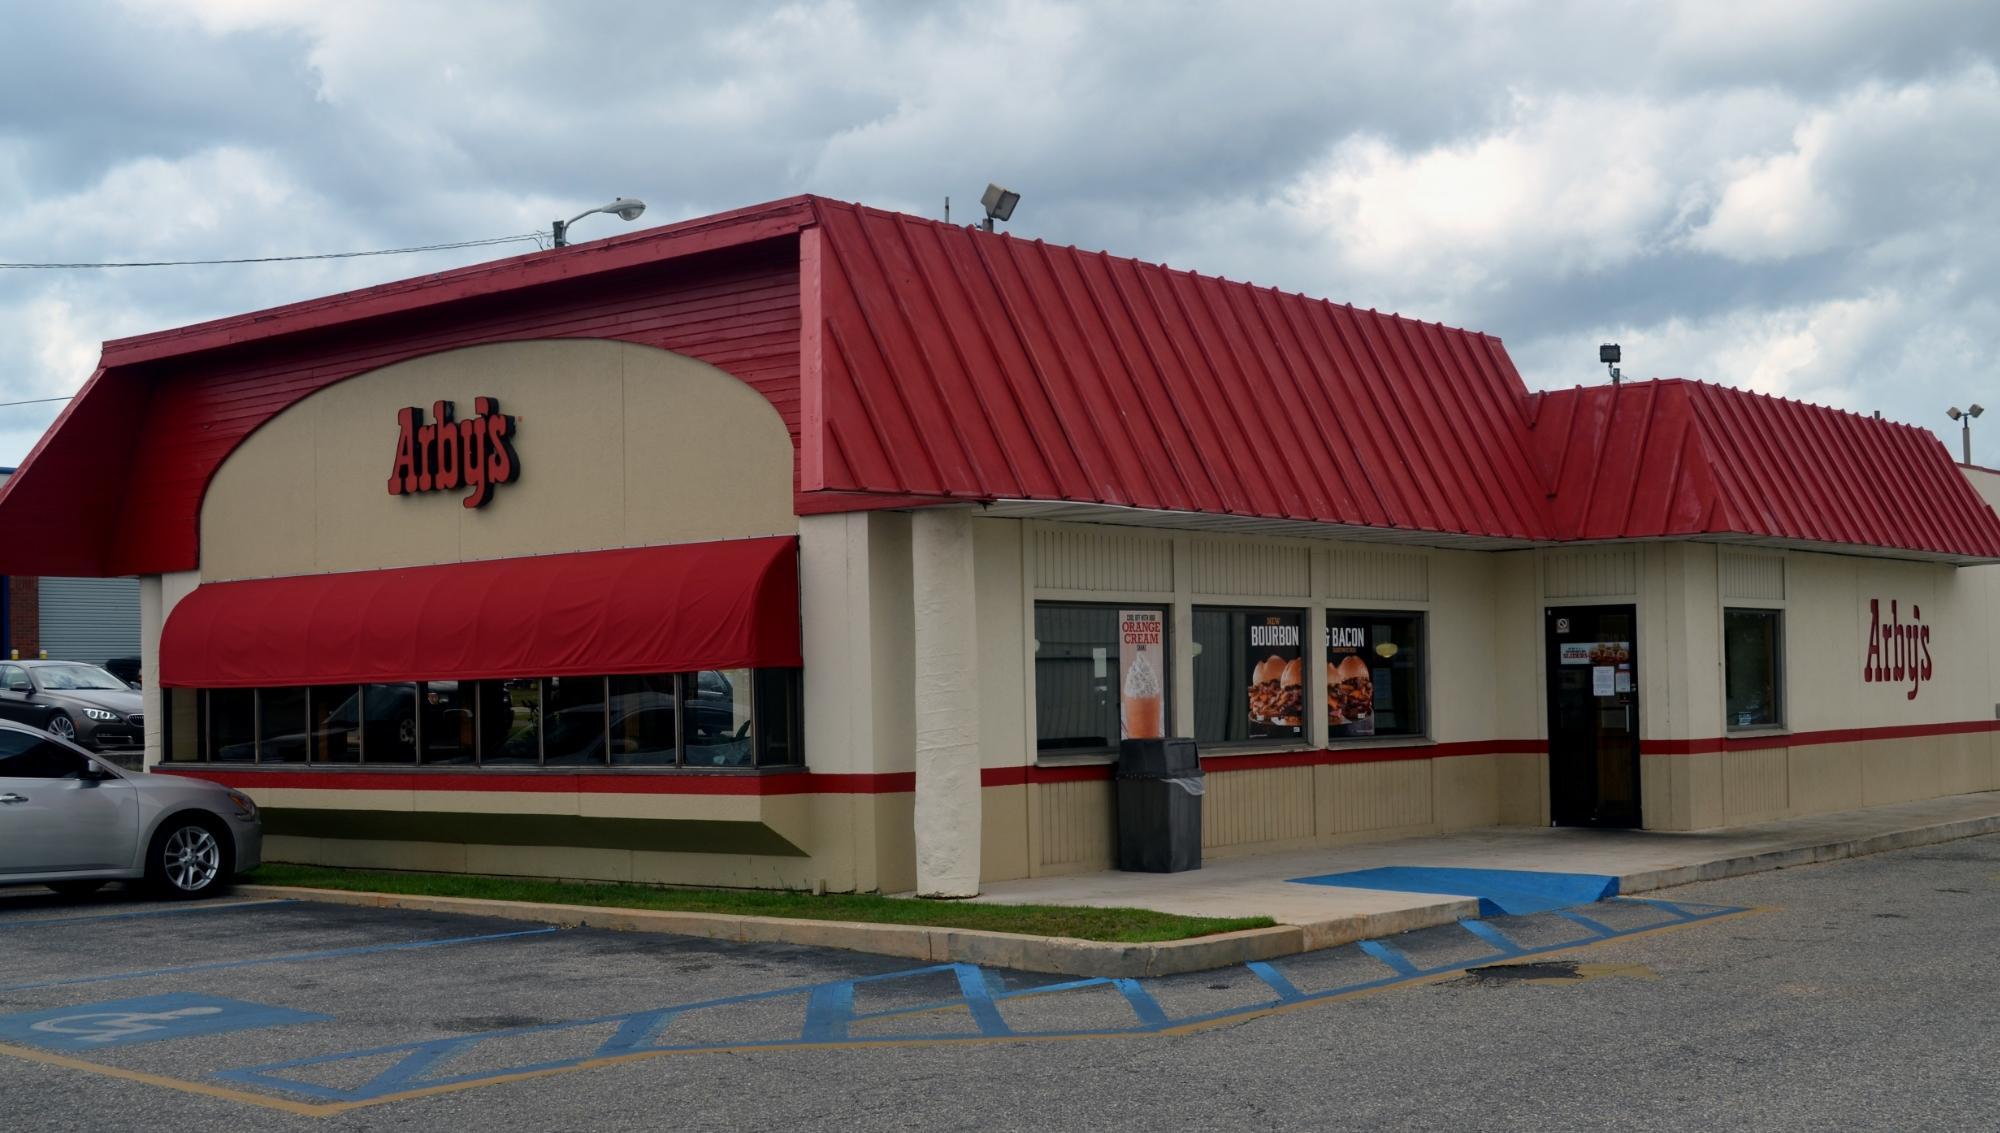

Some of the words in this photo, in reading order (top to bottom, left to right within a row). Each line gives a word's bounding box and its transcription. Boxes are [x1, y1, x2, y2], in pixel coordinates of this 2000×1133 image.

[388, 396, 517, 510] Arby's
[1122, 621, 1161, 633] ORANGE
[1266, 616, 1281, 625] NEW
[1124, 633, 1159, 645] CREAM
[1251, 625, 1299, 646] BOURBON
[1332, 627, 1365, 647] BACON
[1864, 599, 1932, 700] Arby's
